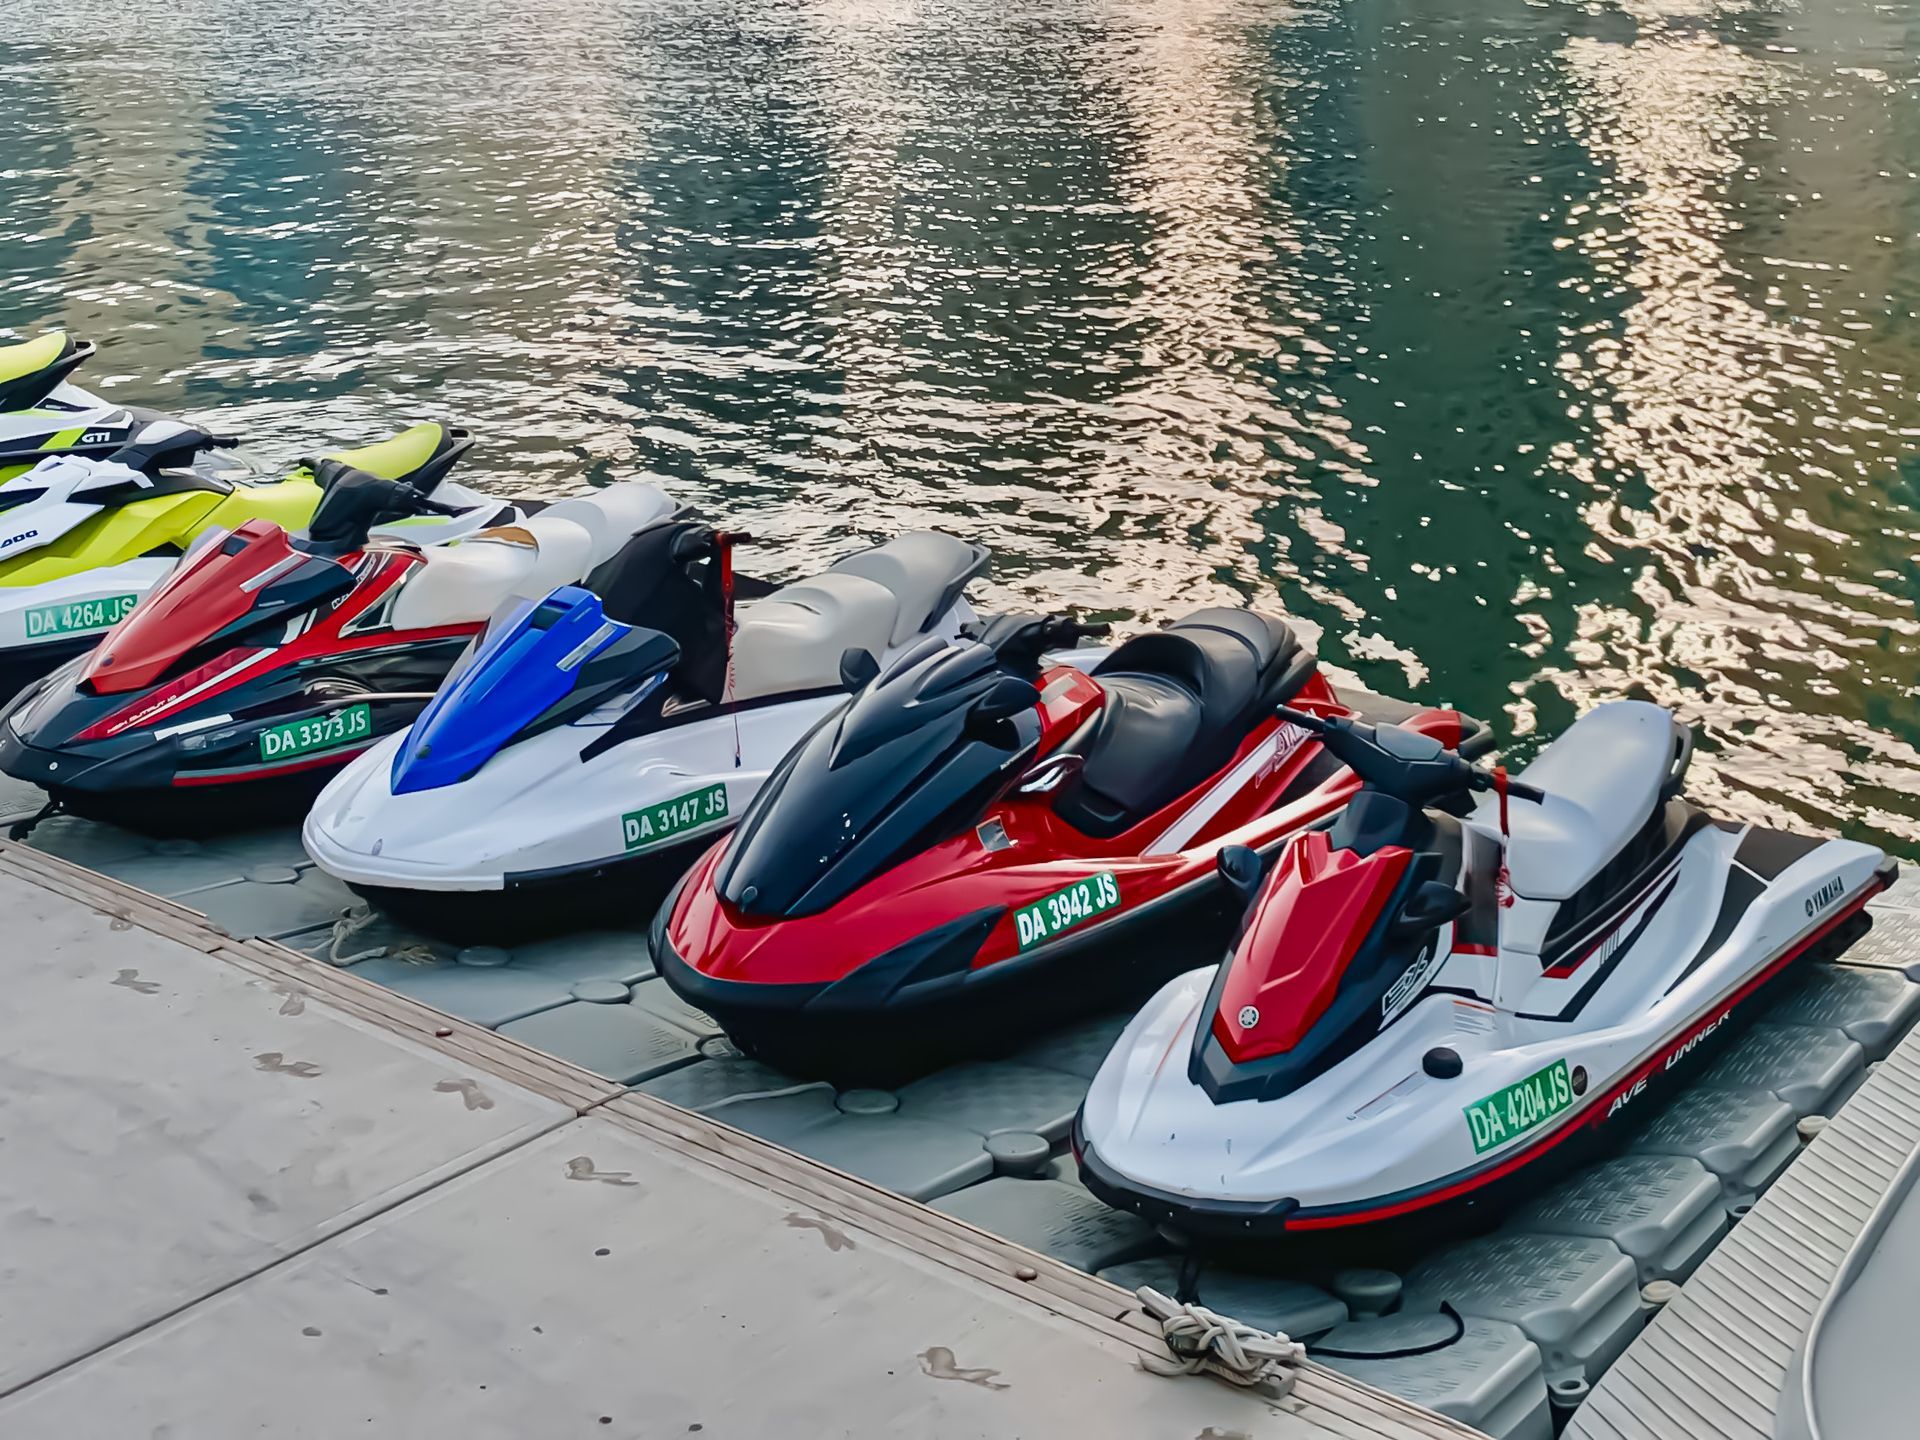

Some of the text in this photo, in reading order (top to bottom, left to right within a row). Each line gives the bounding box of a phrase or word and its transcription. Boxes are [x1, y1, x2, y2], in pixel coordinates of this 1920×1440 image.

[81, 432, 110, 443] GTI
[28, 598, 134, 635] DA 4264 JS
[265, 710, 366, 755] DA 3373 JS
[625, 789, 725, 842] DA 3147 JS
[1017, 873, 1117, 946] DA 3942 JS
[1469, 1065, 1569, 1148] DA 4204 JS
